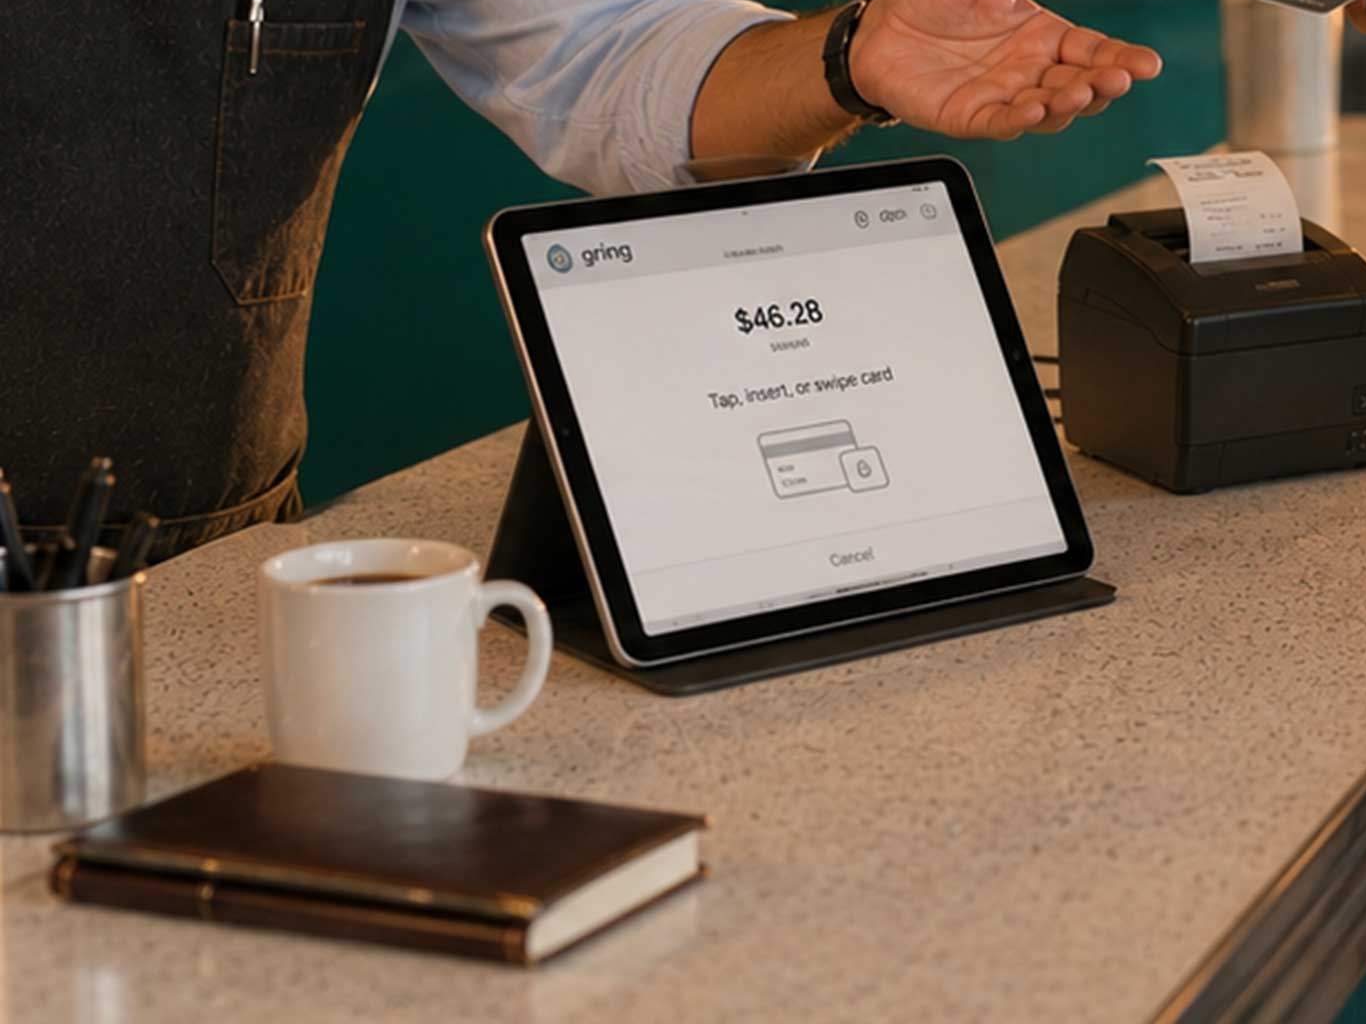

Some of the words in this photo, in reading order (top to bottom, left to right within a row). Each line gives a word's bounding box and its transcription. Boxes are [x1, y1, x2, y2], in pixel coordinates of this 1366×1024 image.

[581, 242, 633, 268] gring
[734, 298, 823, 334] $46.28
[708, 393, 743, 409] Tap,
[745, 384, 794, 403] insert,
[795, 382, 811, 395] or
[814, 375, 858, 391] swipe
[861, 366, 893, 385] card
[829, 546, 874, 567] Cancel
